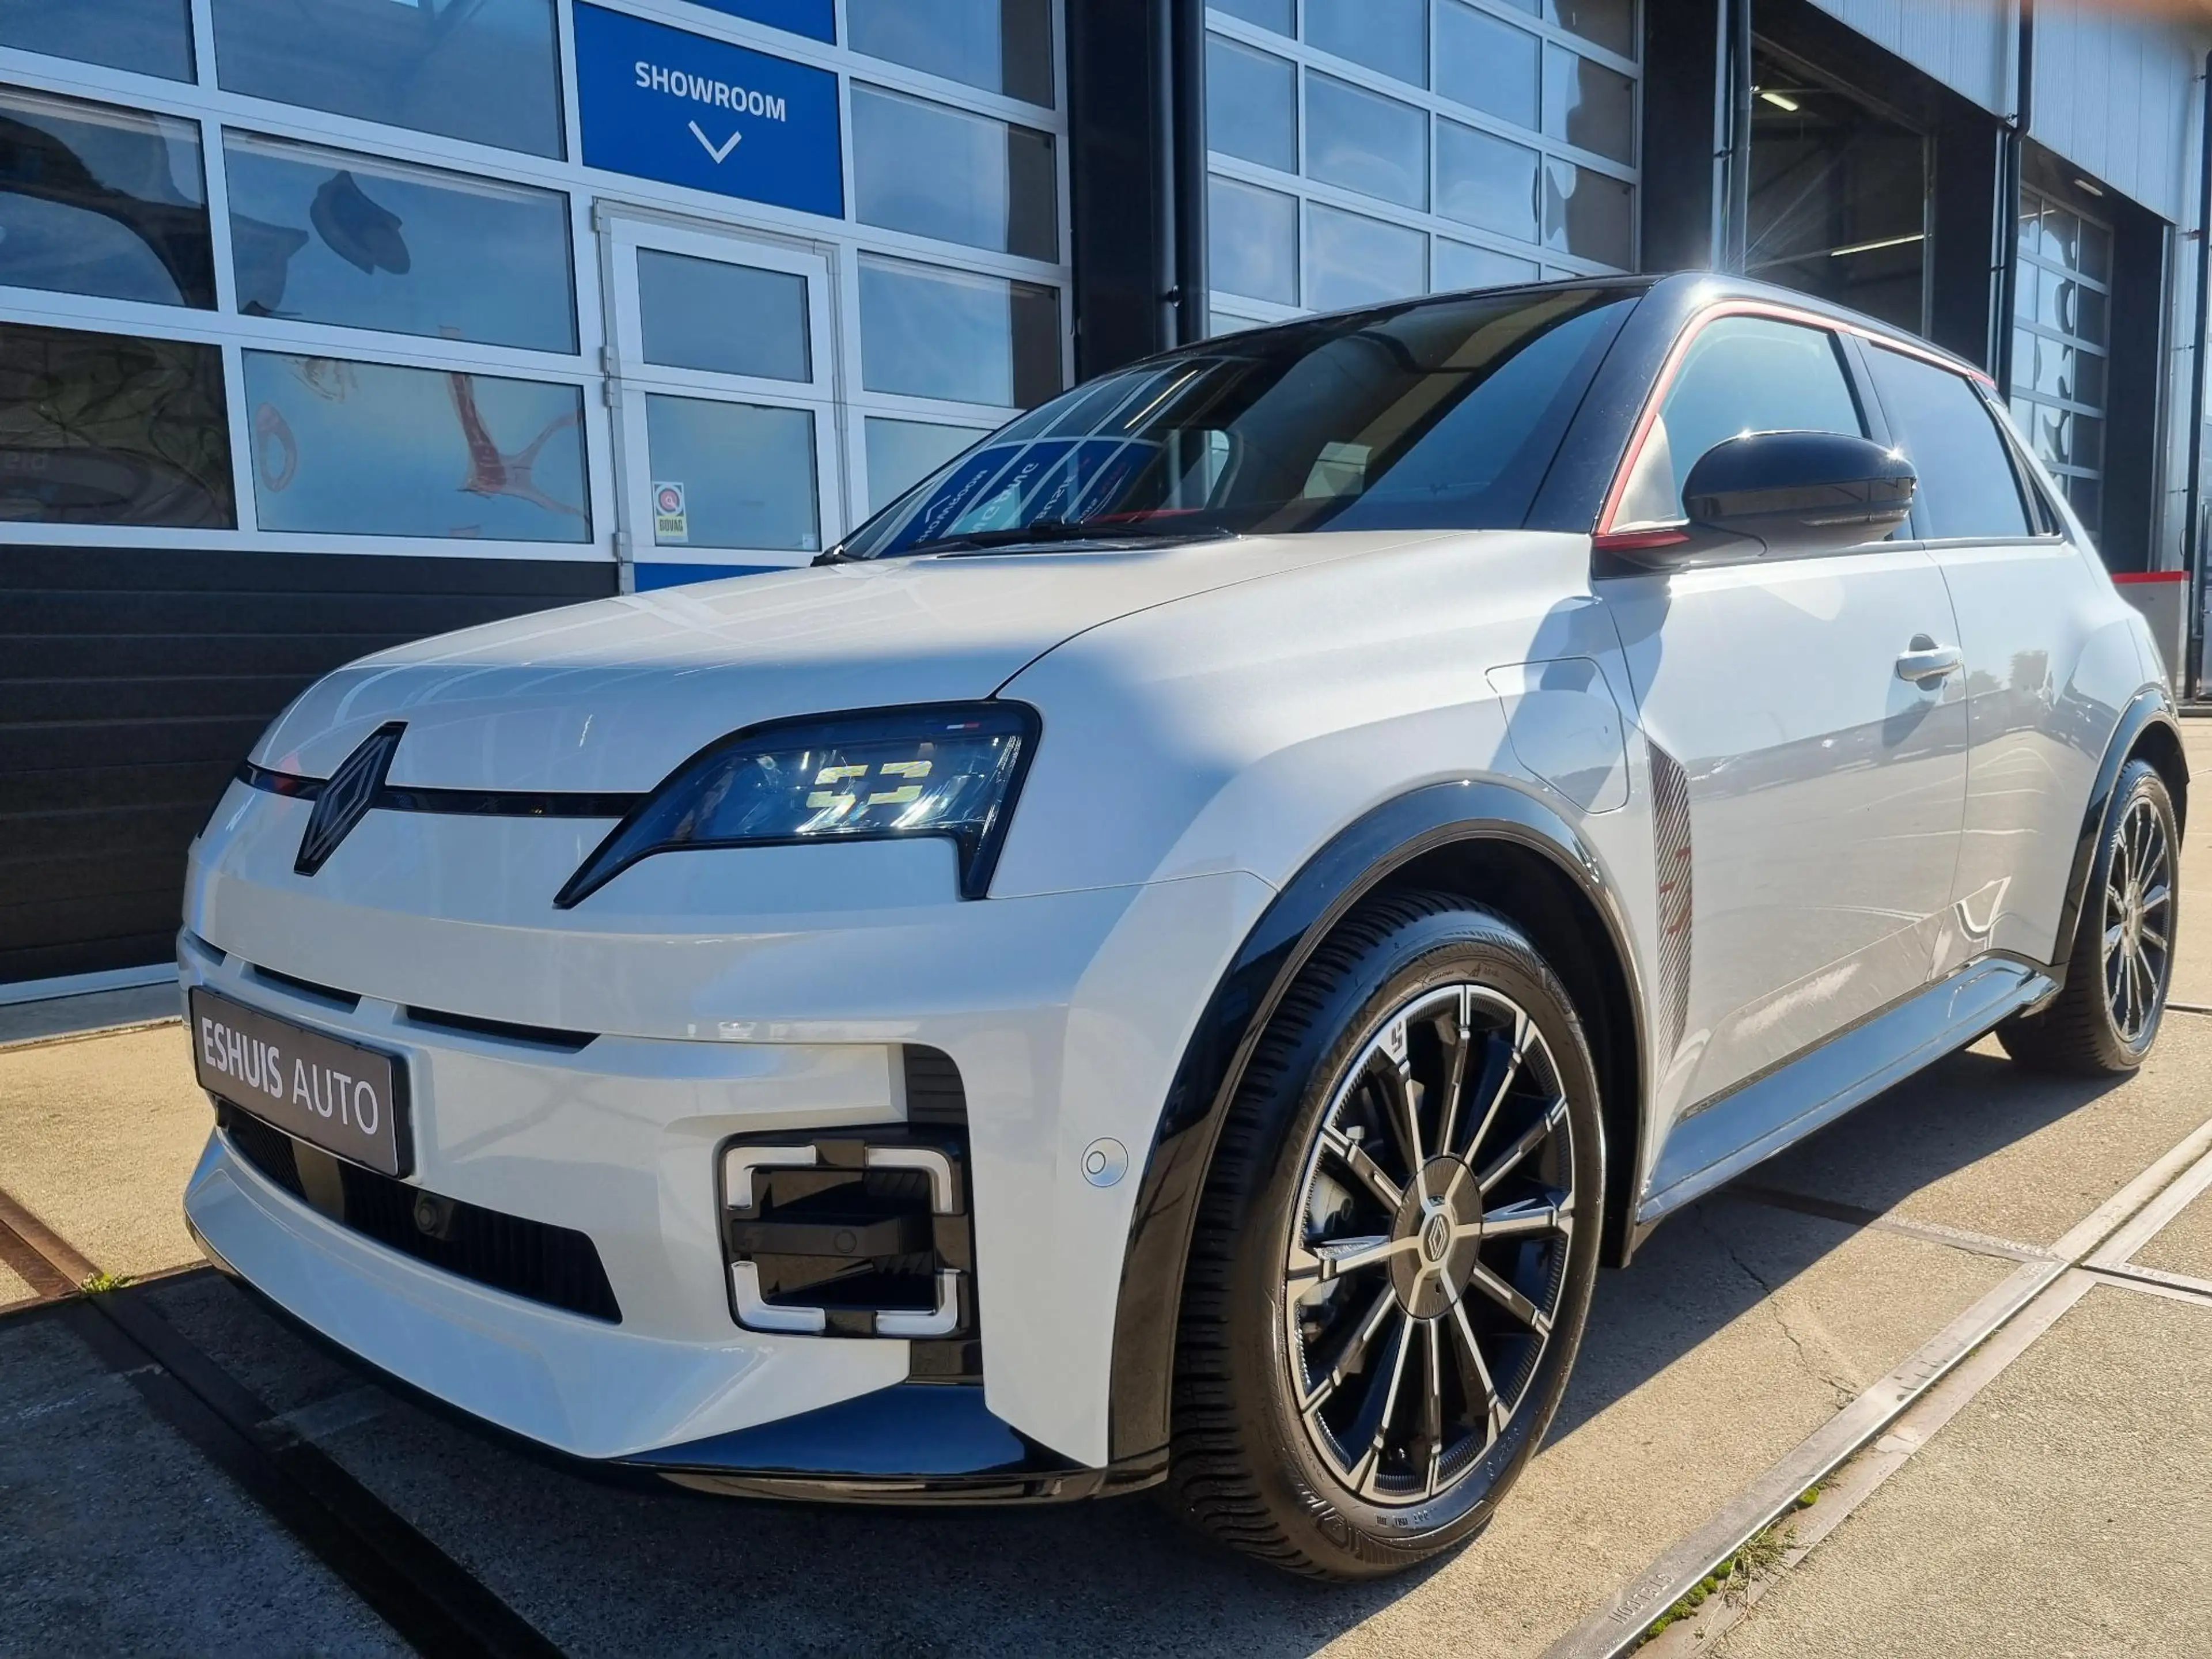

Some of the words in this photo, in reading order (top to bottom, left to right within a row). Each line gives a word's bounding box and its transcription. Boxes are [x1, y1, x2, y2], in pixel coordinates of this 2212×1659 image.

[635, 61, 786, 122] SHOWROOM
[201, 1017, 283, 1098] ESHUIS
[293, 1058, 378, 1135] AUTO
